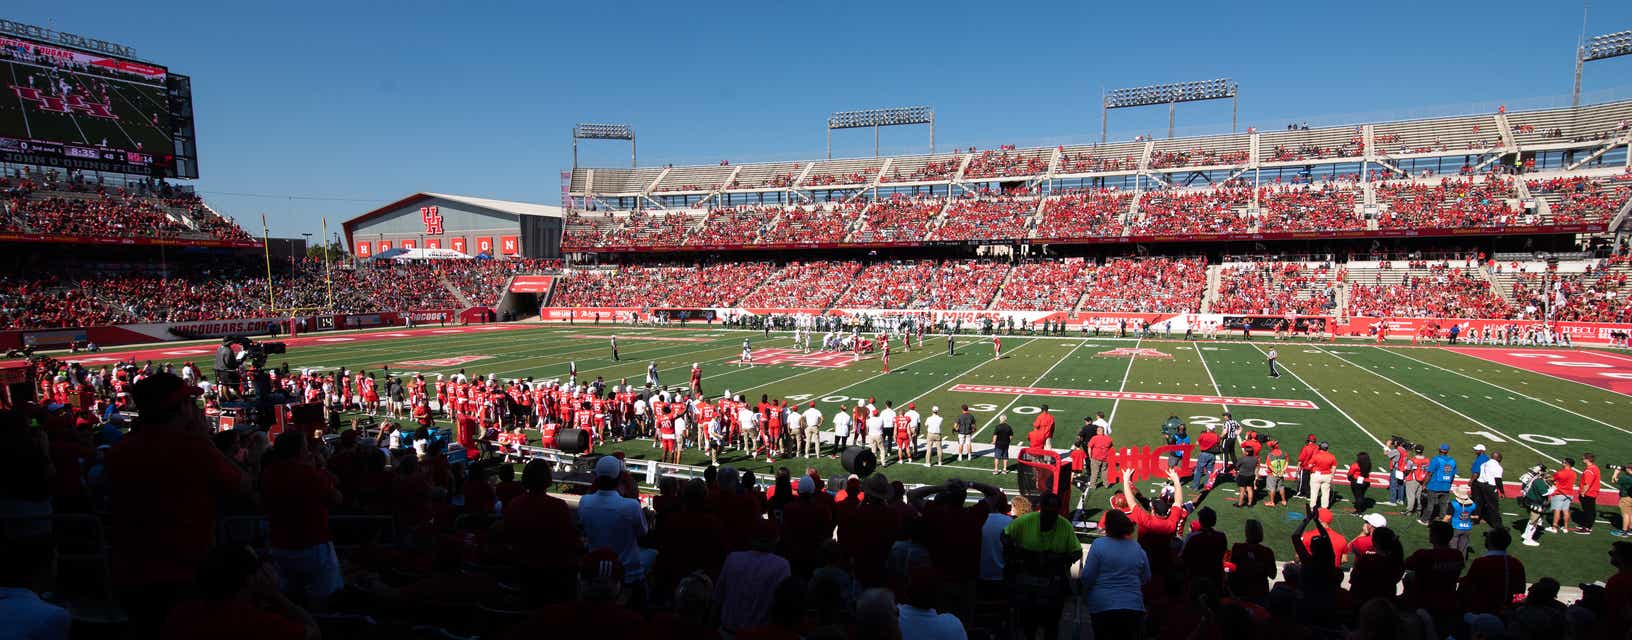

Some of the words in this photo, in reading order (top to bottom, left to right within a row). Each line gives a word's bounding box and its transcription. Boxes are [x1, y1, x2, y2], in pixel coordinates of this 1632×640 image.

[59, 31, 137, 59] STADIUM
[20, 143, 28, 151] 0
[71, 148, 96, 158] 8:35
[4, 153, 45, 165] JOHN
[113, 163, 152, 174] FIELD
[143, 156, 153, 164] 14
[420, 206, 443, 235] UH
[956, 385, 1037, 394] JOHN
[1201, 397, 1310, 408] FIELD
[580, 415, 590, 425] 27
[897, 420, 907, 429] 37
